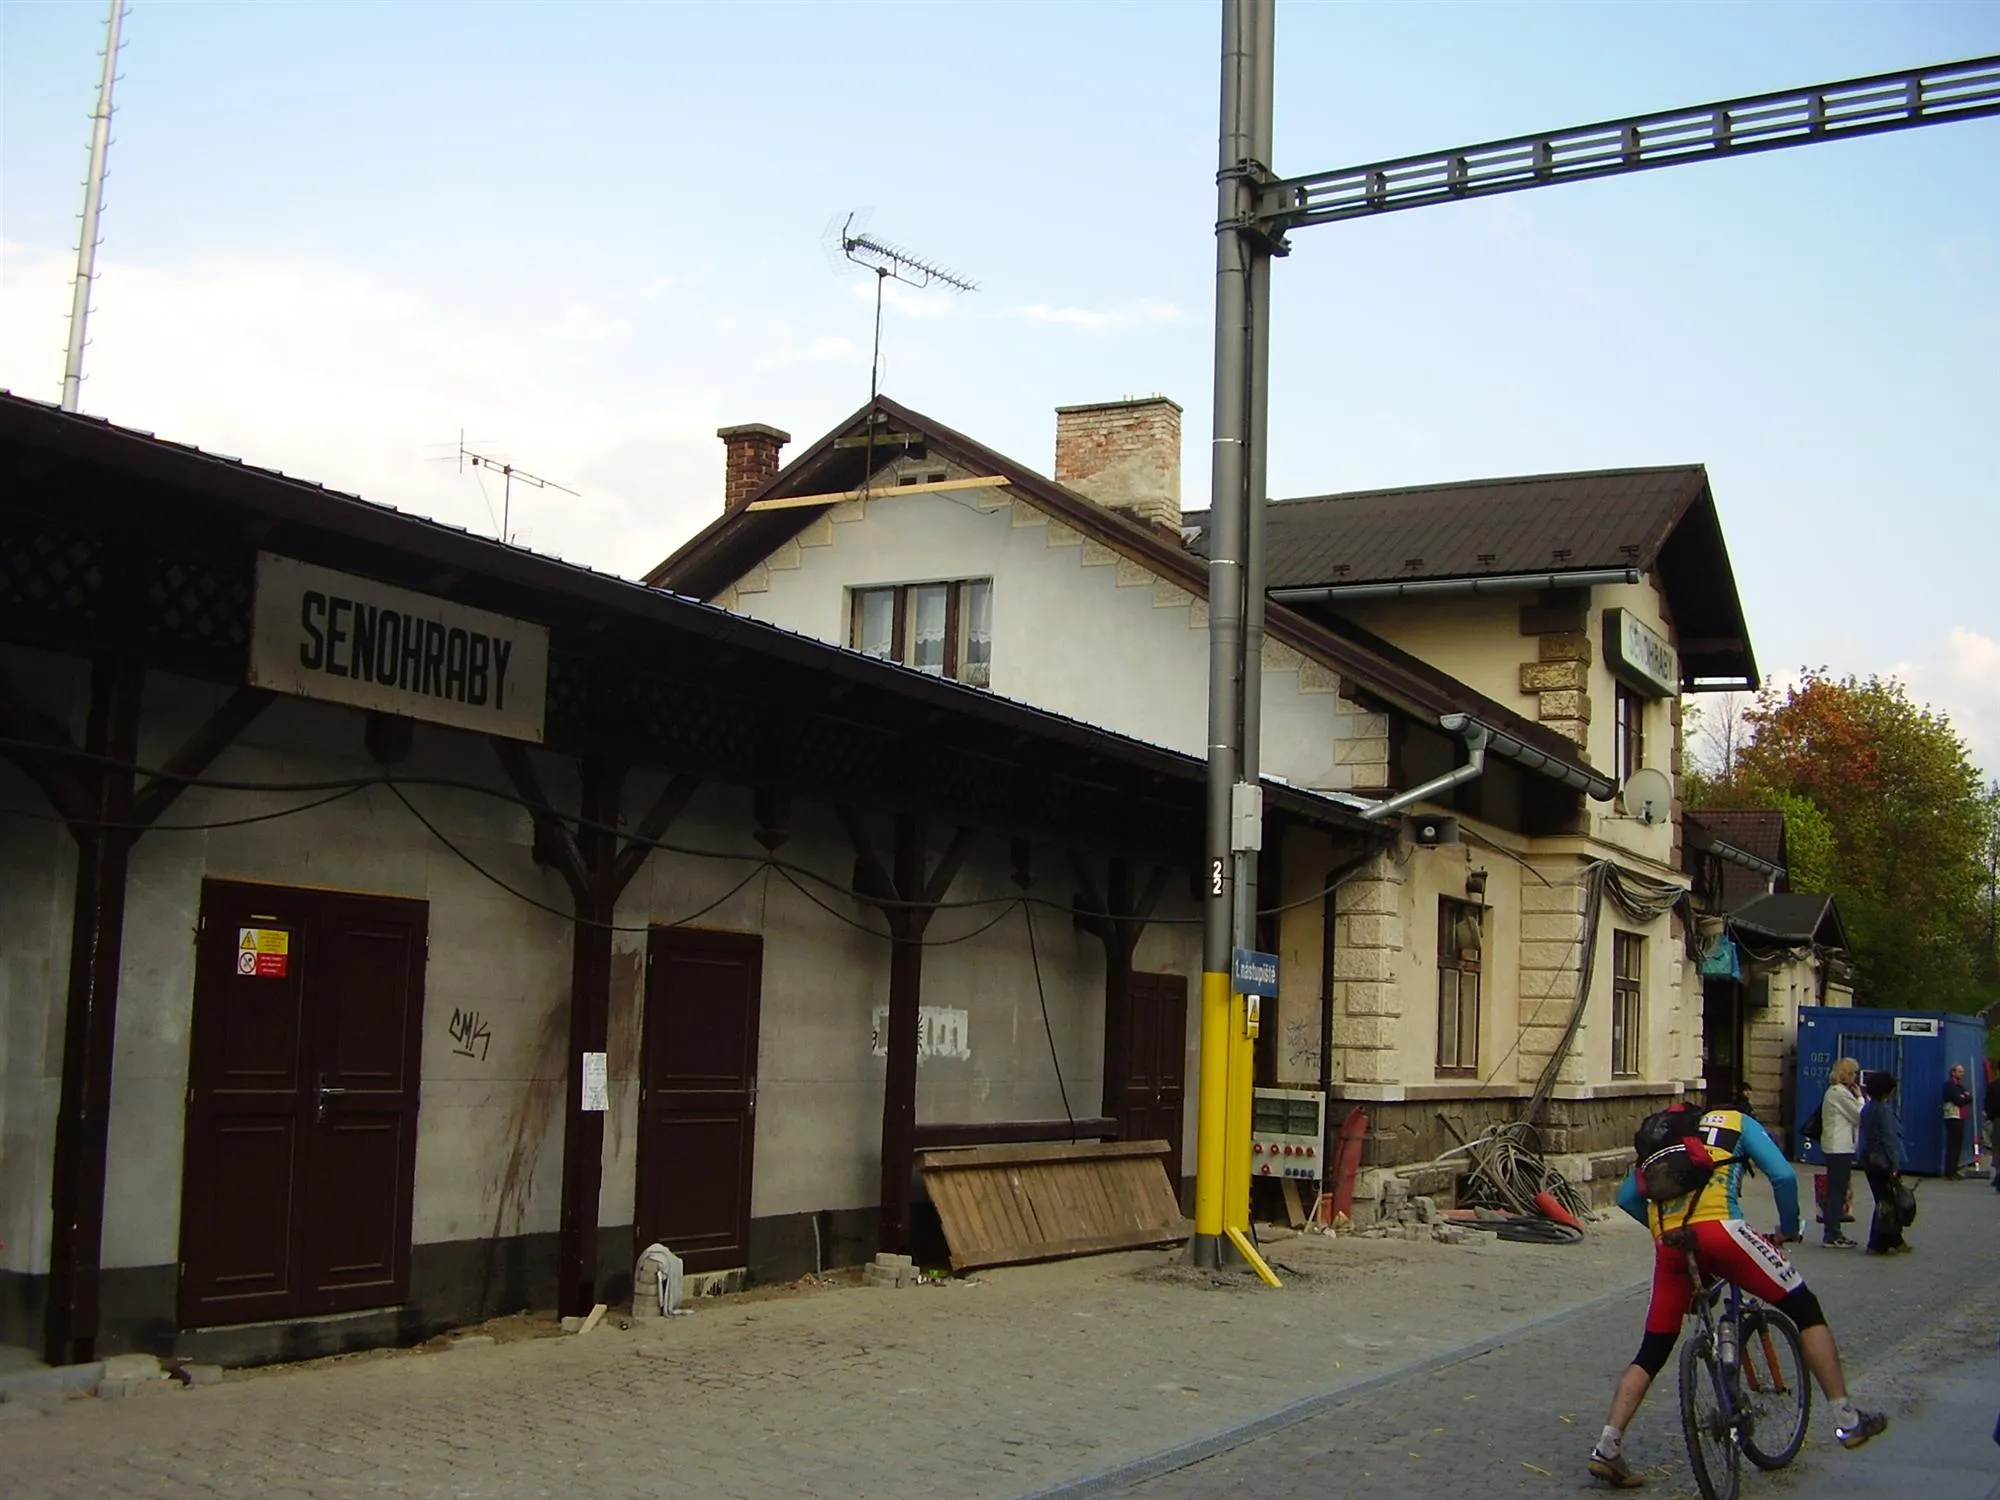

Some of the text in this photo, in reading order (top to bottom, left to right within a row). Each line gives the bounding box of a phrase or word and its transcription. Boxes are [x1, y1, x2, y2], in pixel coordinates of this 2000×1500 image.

[300, 591, 512, 710] SENOHRABY
[1628, 621, 1673, 682] SOHRABY
[1738, 1226, 1783, 1269] WHEELER
